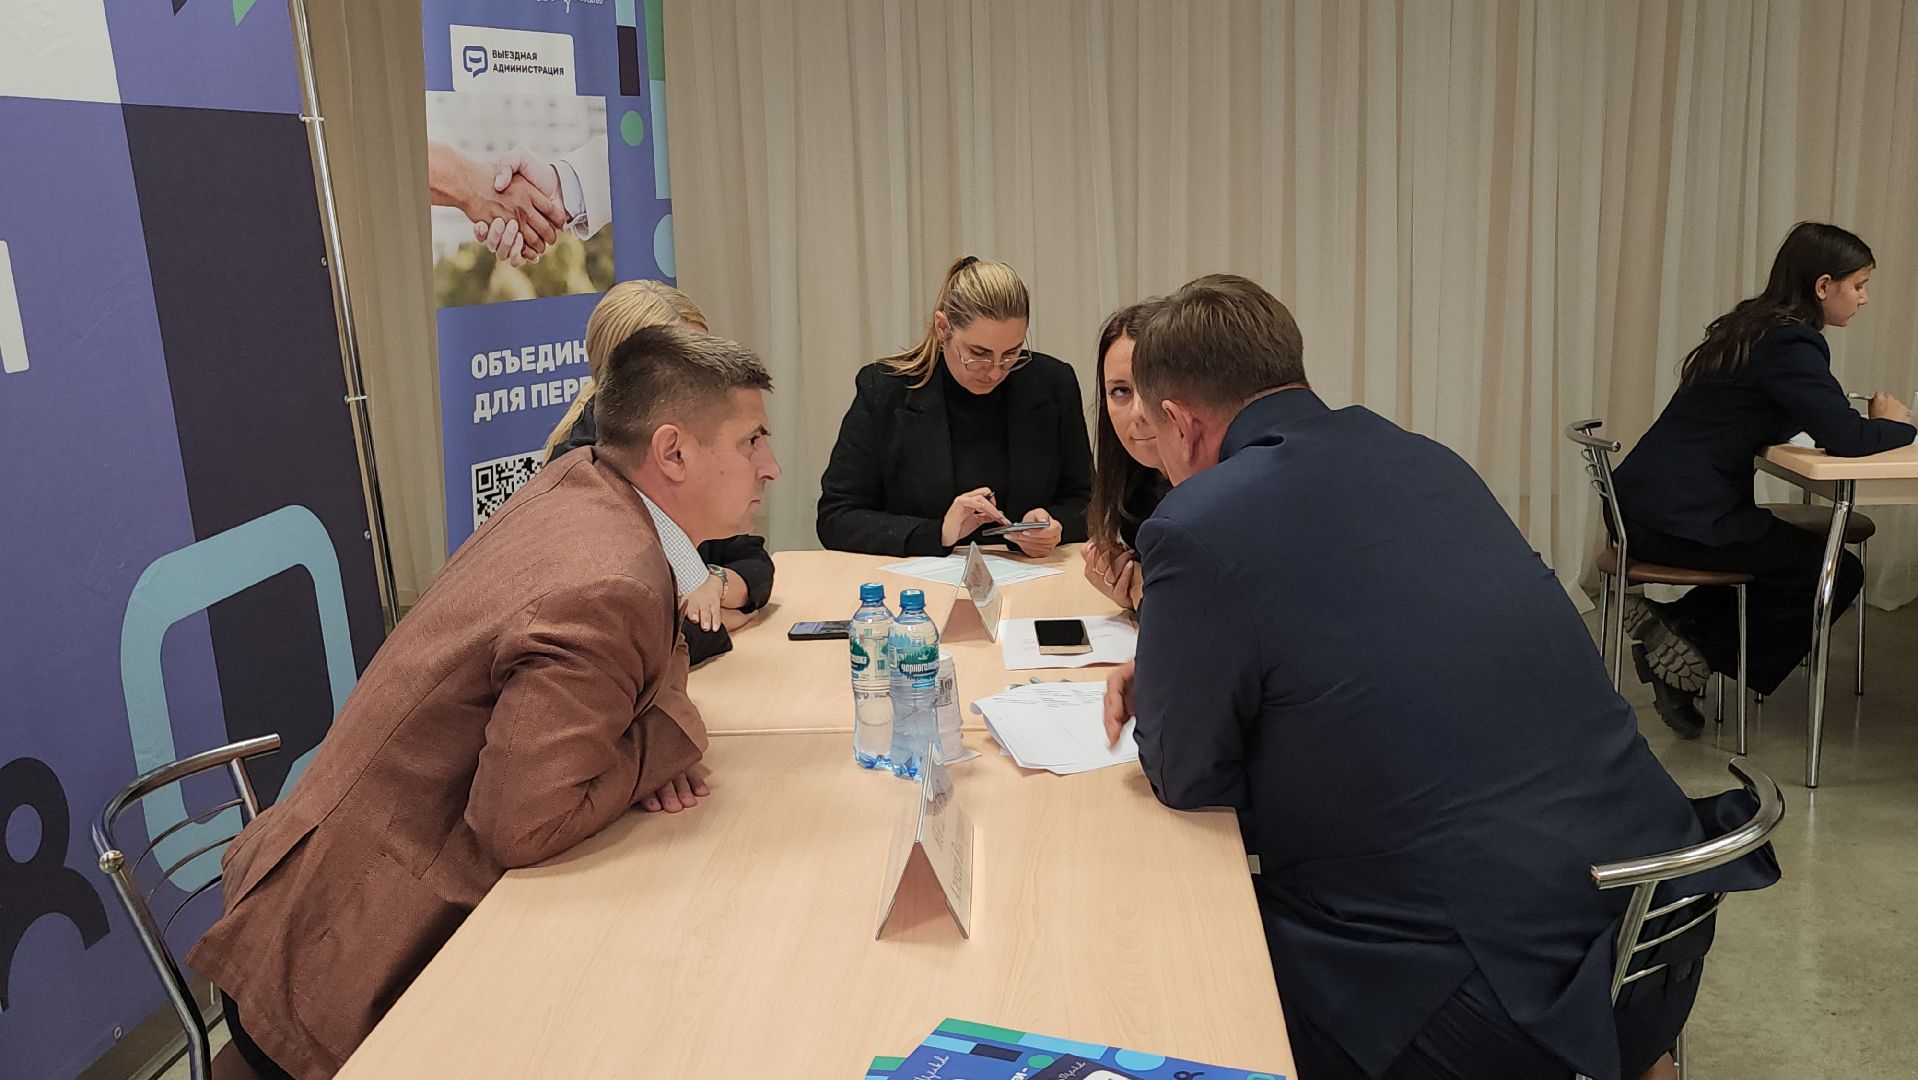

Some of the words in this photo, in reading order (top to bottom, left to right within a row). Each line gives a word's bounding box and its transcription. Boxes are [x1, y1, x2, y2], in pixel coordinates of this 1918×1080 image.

[492, 50, 538, 61] ВЫЕЗДНАЯ
[493, 63, 565, 76] АДМИНИСТРАЦИЯ
[473, 386, 525, 424] ДЛЯ
